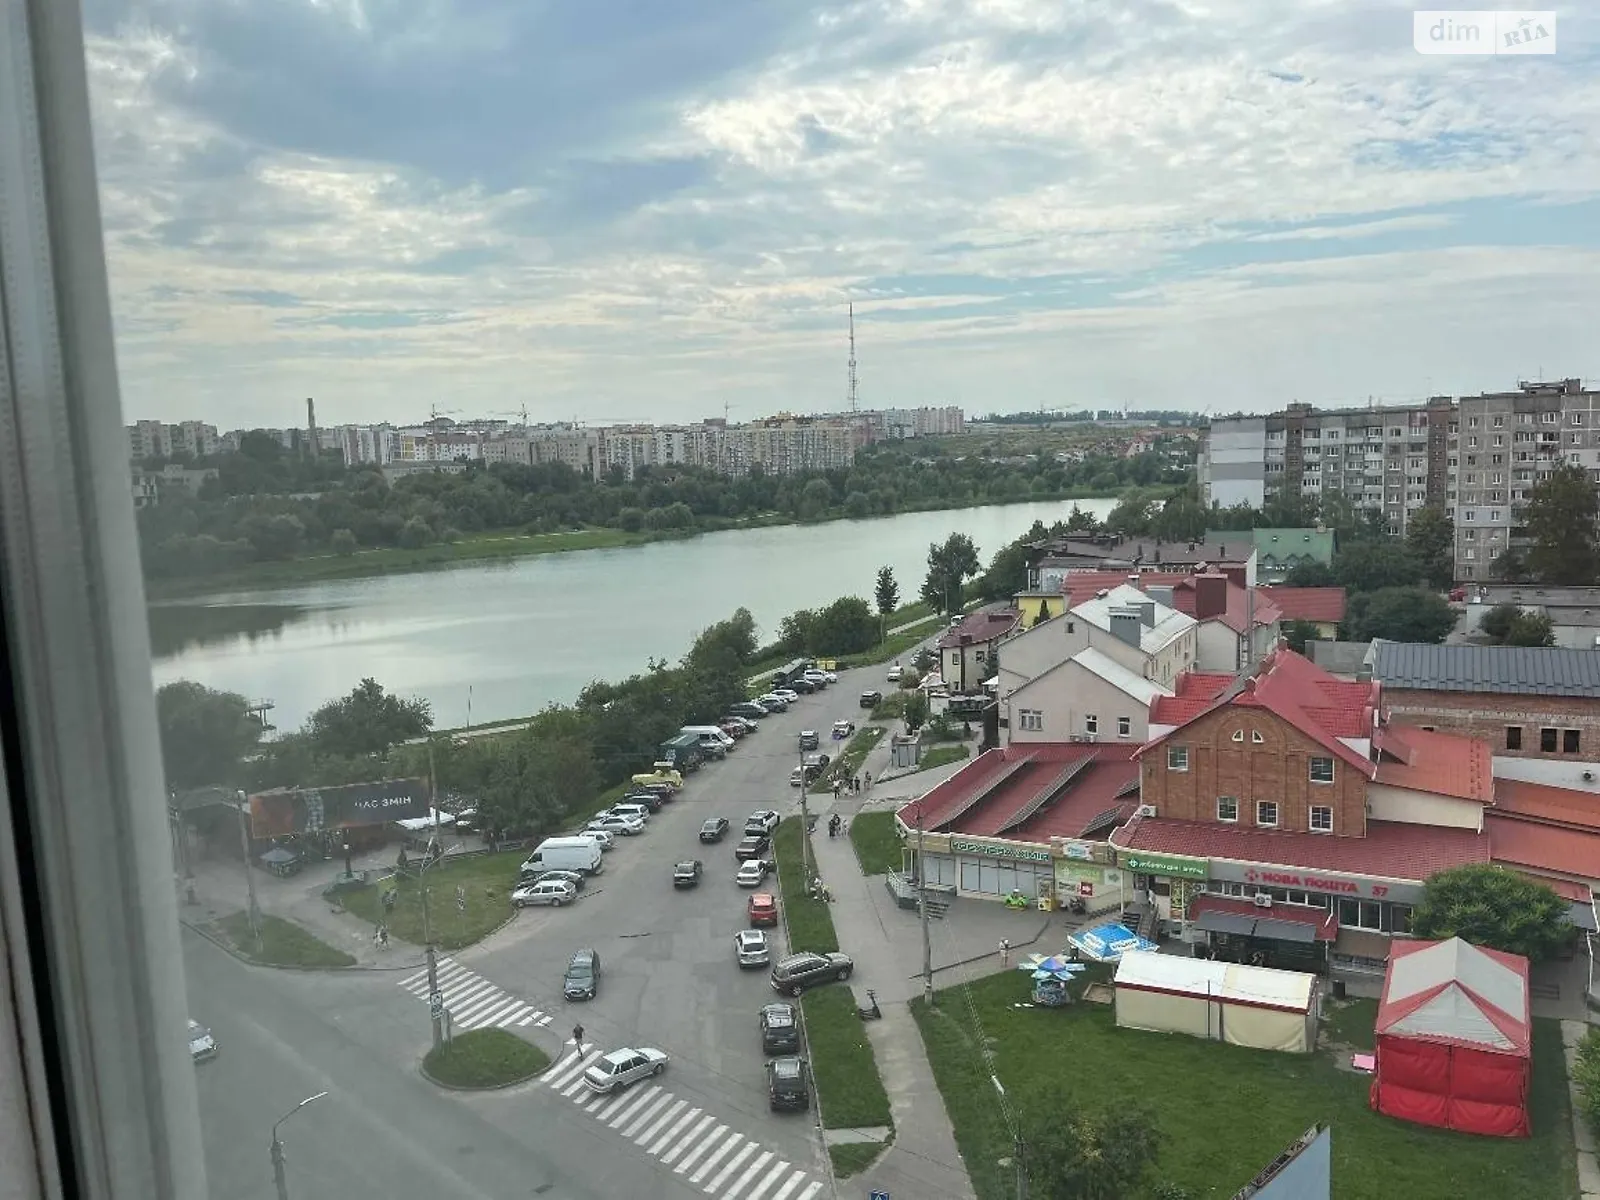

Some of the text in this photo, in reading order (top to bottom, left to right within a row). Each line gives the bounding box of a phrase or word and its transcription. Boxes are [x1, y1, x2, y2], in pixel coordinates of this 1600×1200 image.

[1260, 872, 1389, 897] НОВА ПОШТА 37
